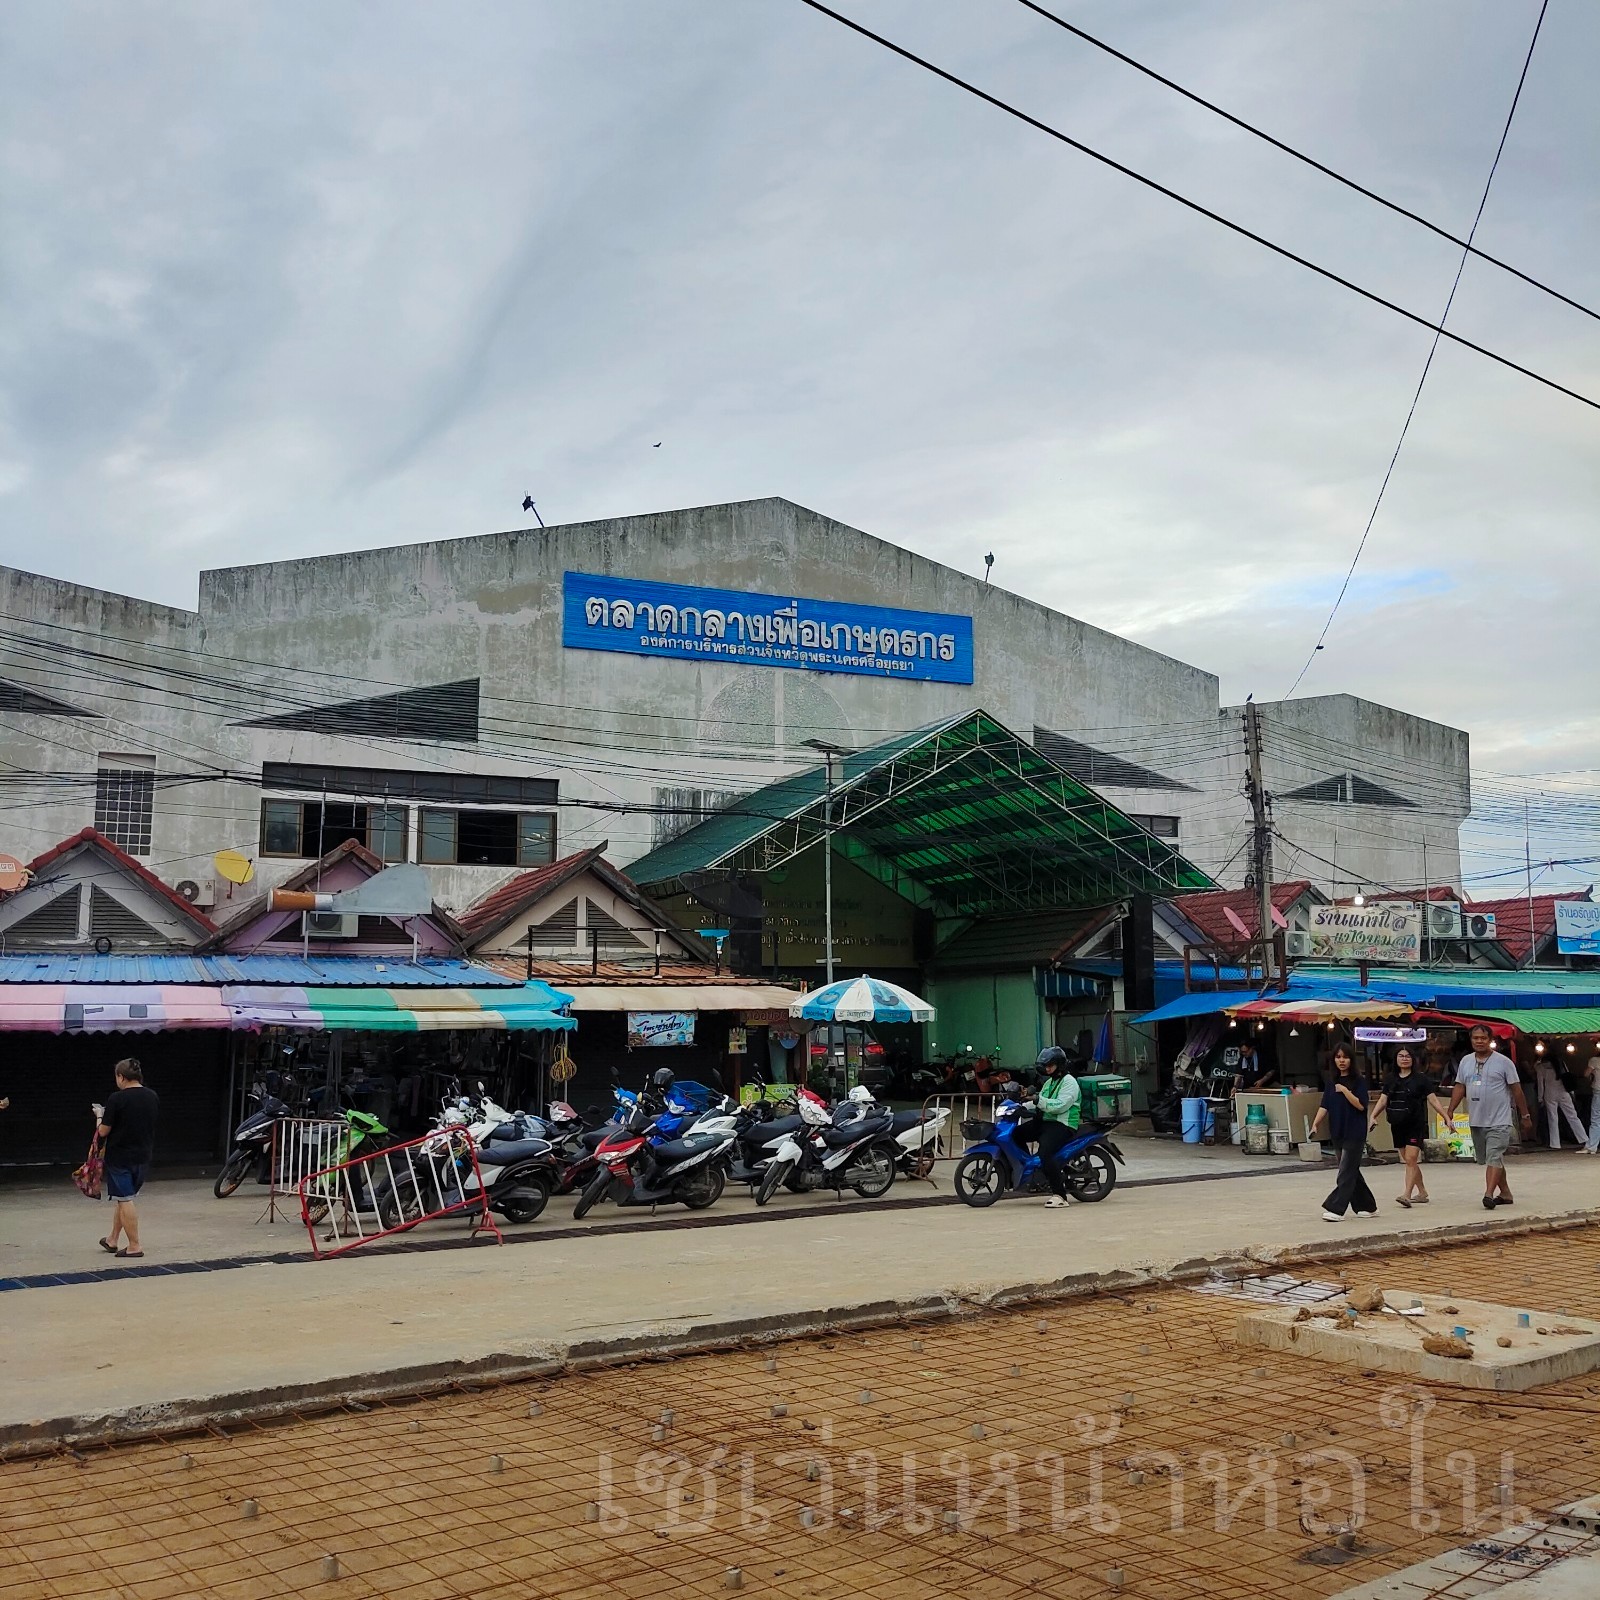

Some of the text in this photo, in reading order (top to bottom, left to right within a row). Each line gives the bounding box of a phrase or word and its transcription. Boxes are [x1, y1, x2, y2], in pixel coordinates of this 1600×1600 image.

[584, 594, 957, 662] ตลาดกลางเพื่อเกษตรกร
[639, 631, 915, 675] องค์การบริหารส่วนจังหวัดพระนครศรีอยุธยา
